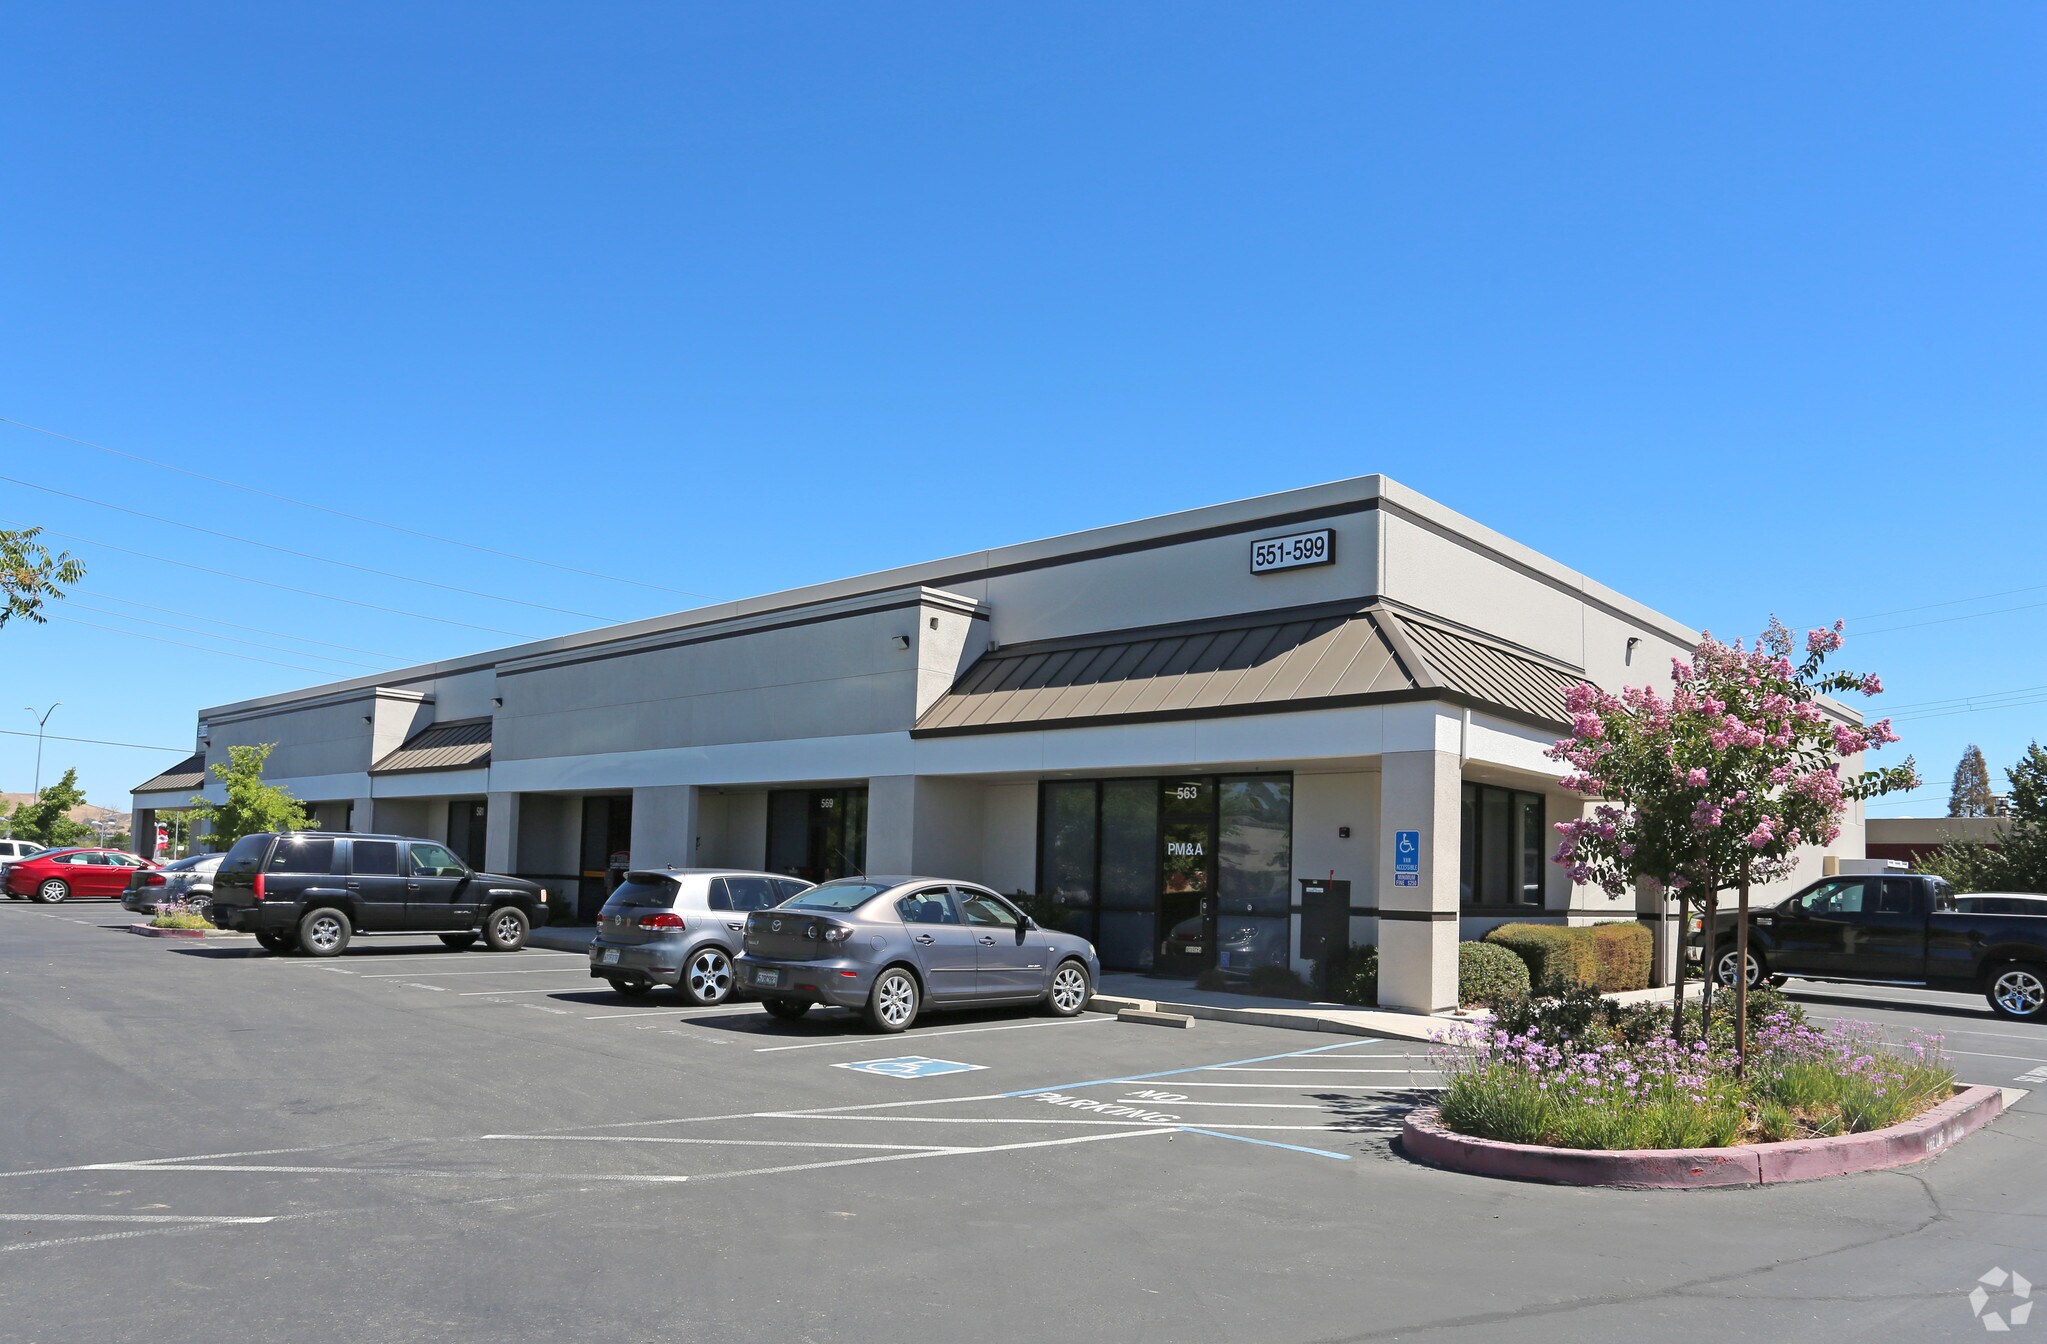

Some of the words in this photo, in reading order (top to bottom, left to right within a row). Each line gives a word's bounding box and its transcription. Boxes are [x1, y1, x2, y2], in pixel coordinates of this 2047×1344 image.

[1255, 536, 1325, 567] 551-599
[1177, 786, 1197, 800] 563
[821, 798, 833, 808] 569
[1167, 842, 1204, 856] PM&A
[1125, 1089, 1189, 1102] NO
[1018, 1092, 1181, 1122] PARKING
